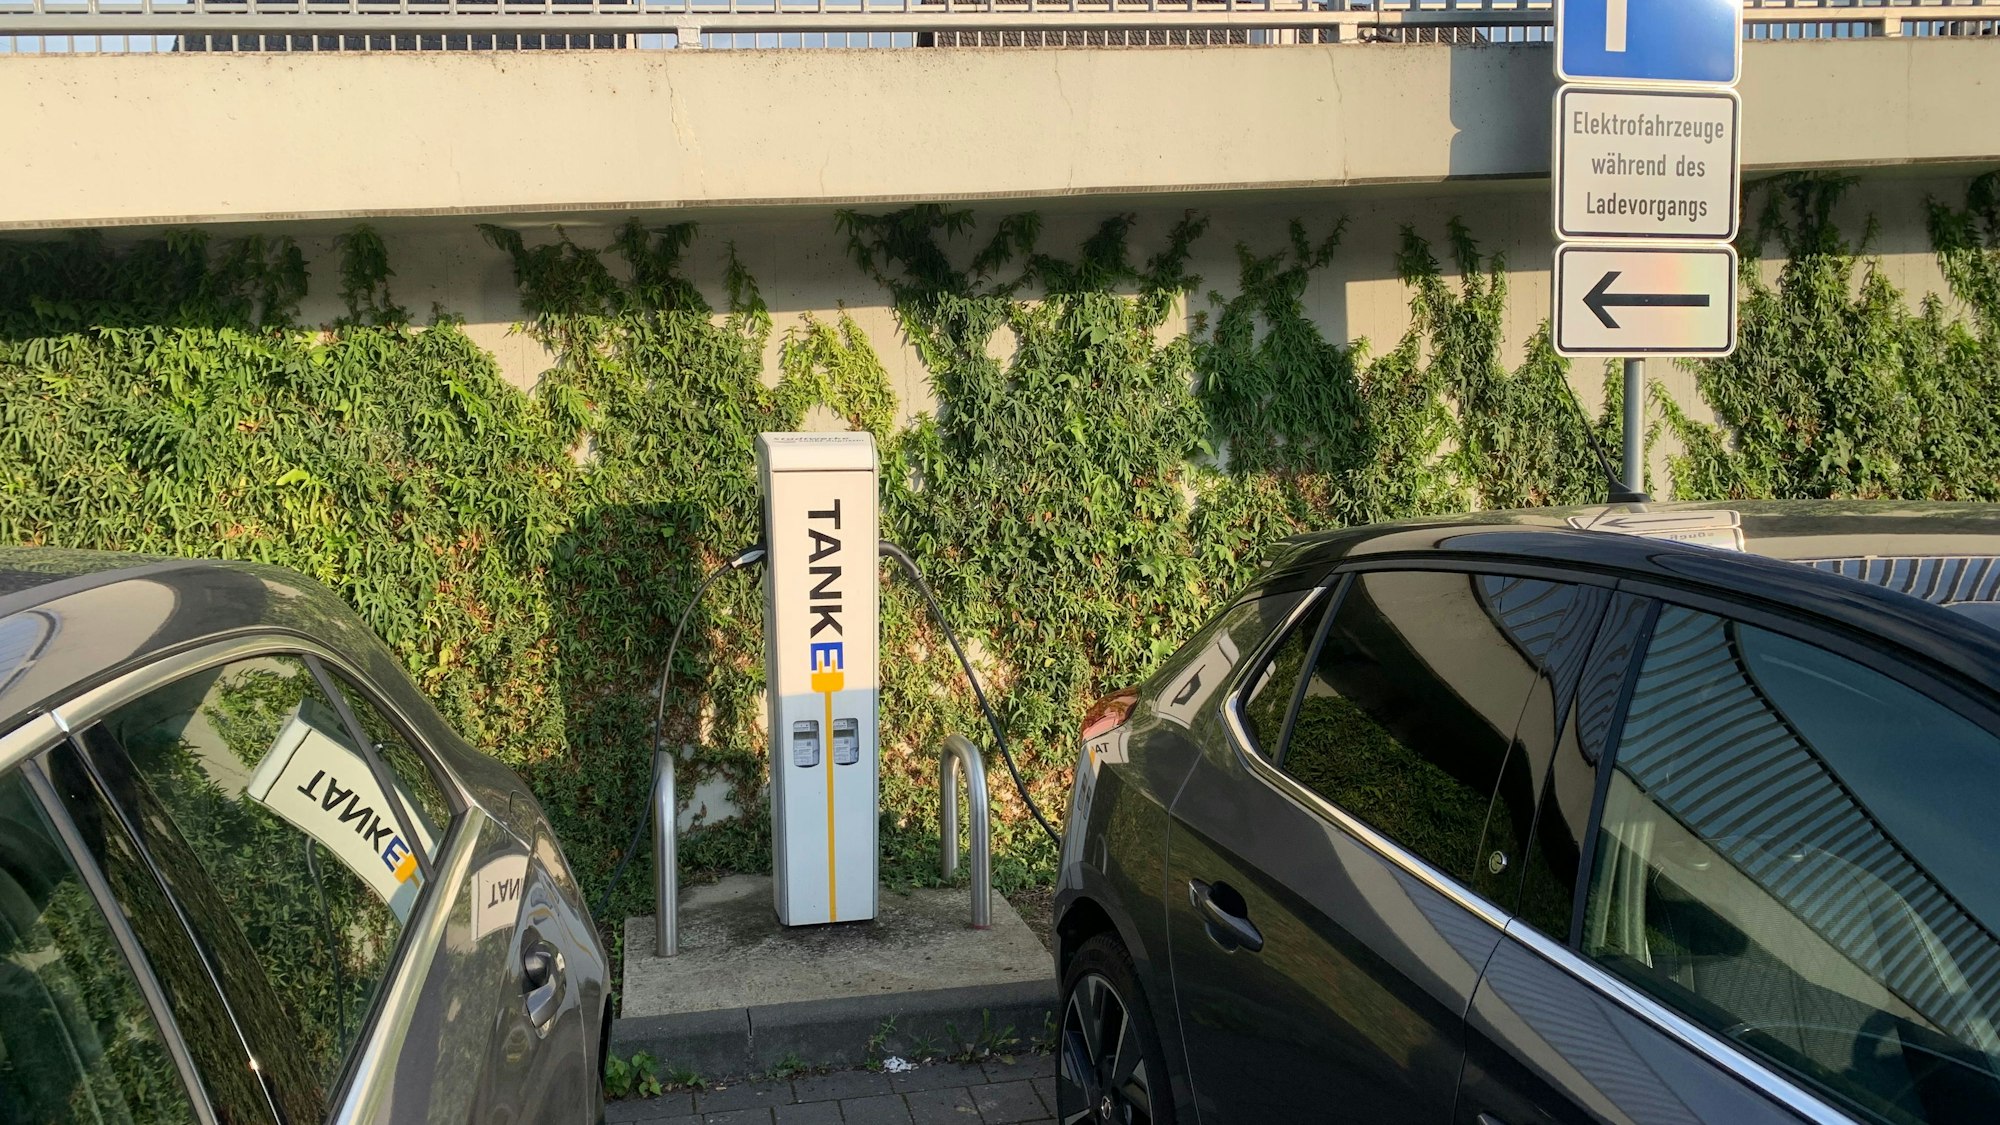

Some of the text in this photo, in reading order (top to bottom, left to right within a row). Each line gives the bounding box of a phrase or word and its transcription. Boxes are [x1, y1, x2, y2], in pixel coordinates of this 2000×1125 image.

[1573, 111, 1724, 144] Elektrofahrzeuge
[1591, 152, 1705, 177] während des
[1586, 191, 1707, 222] Ladevorgangs
[808, 498, 844, 671] TANKE
